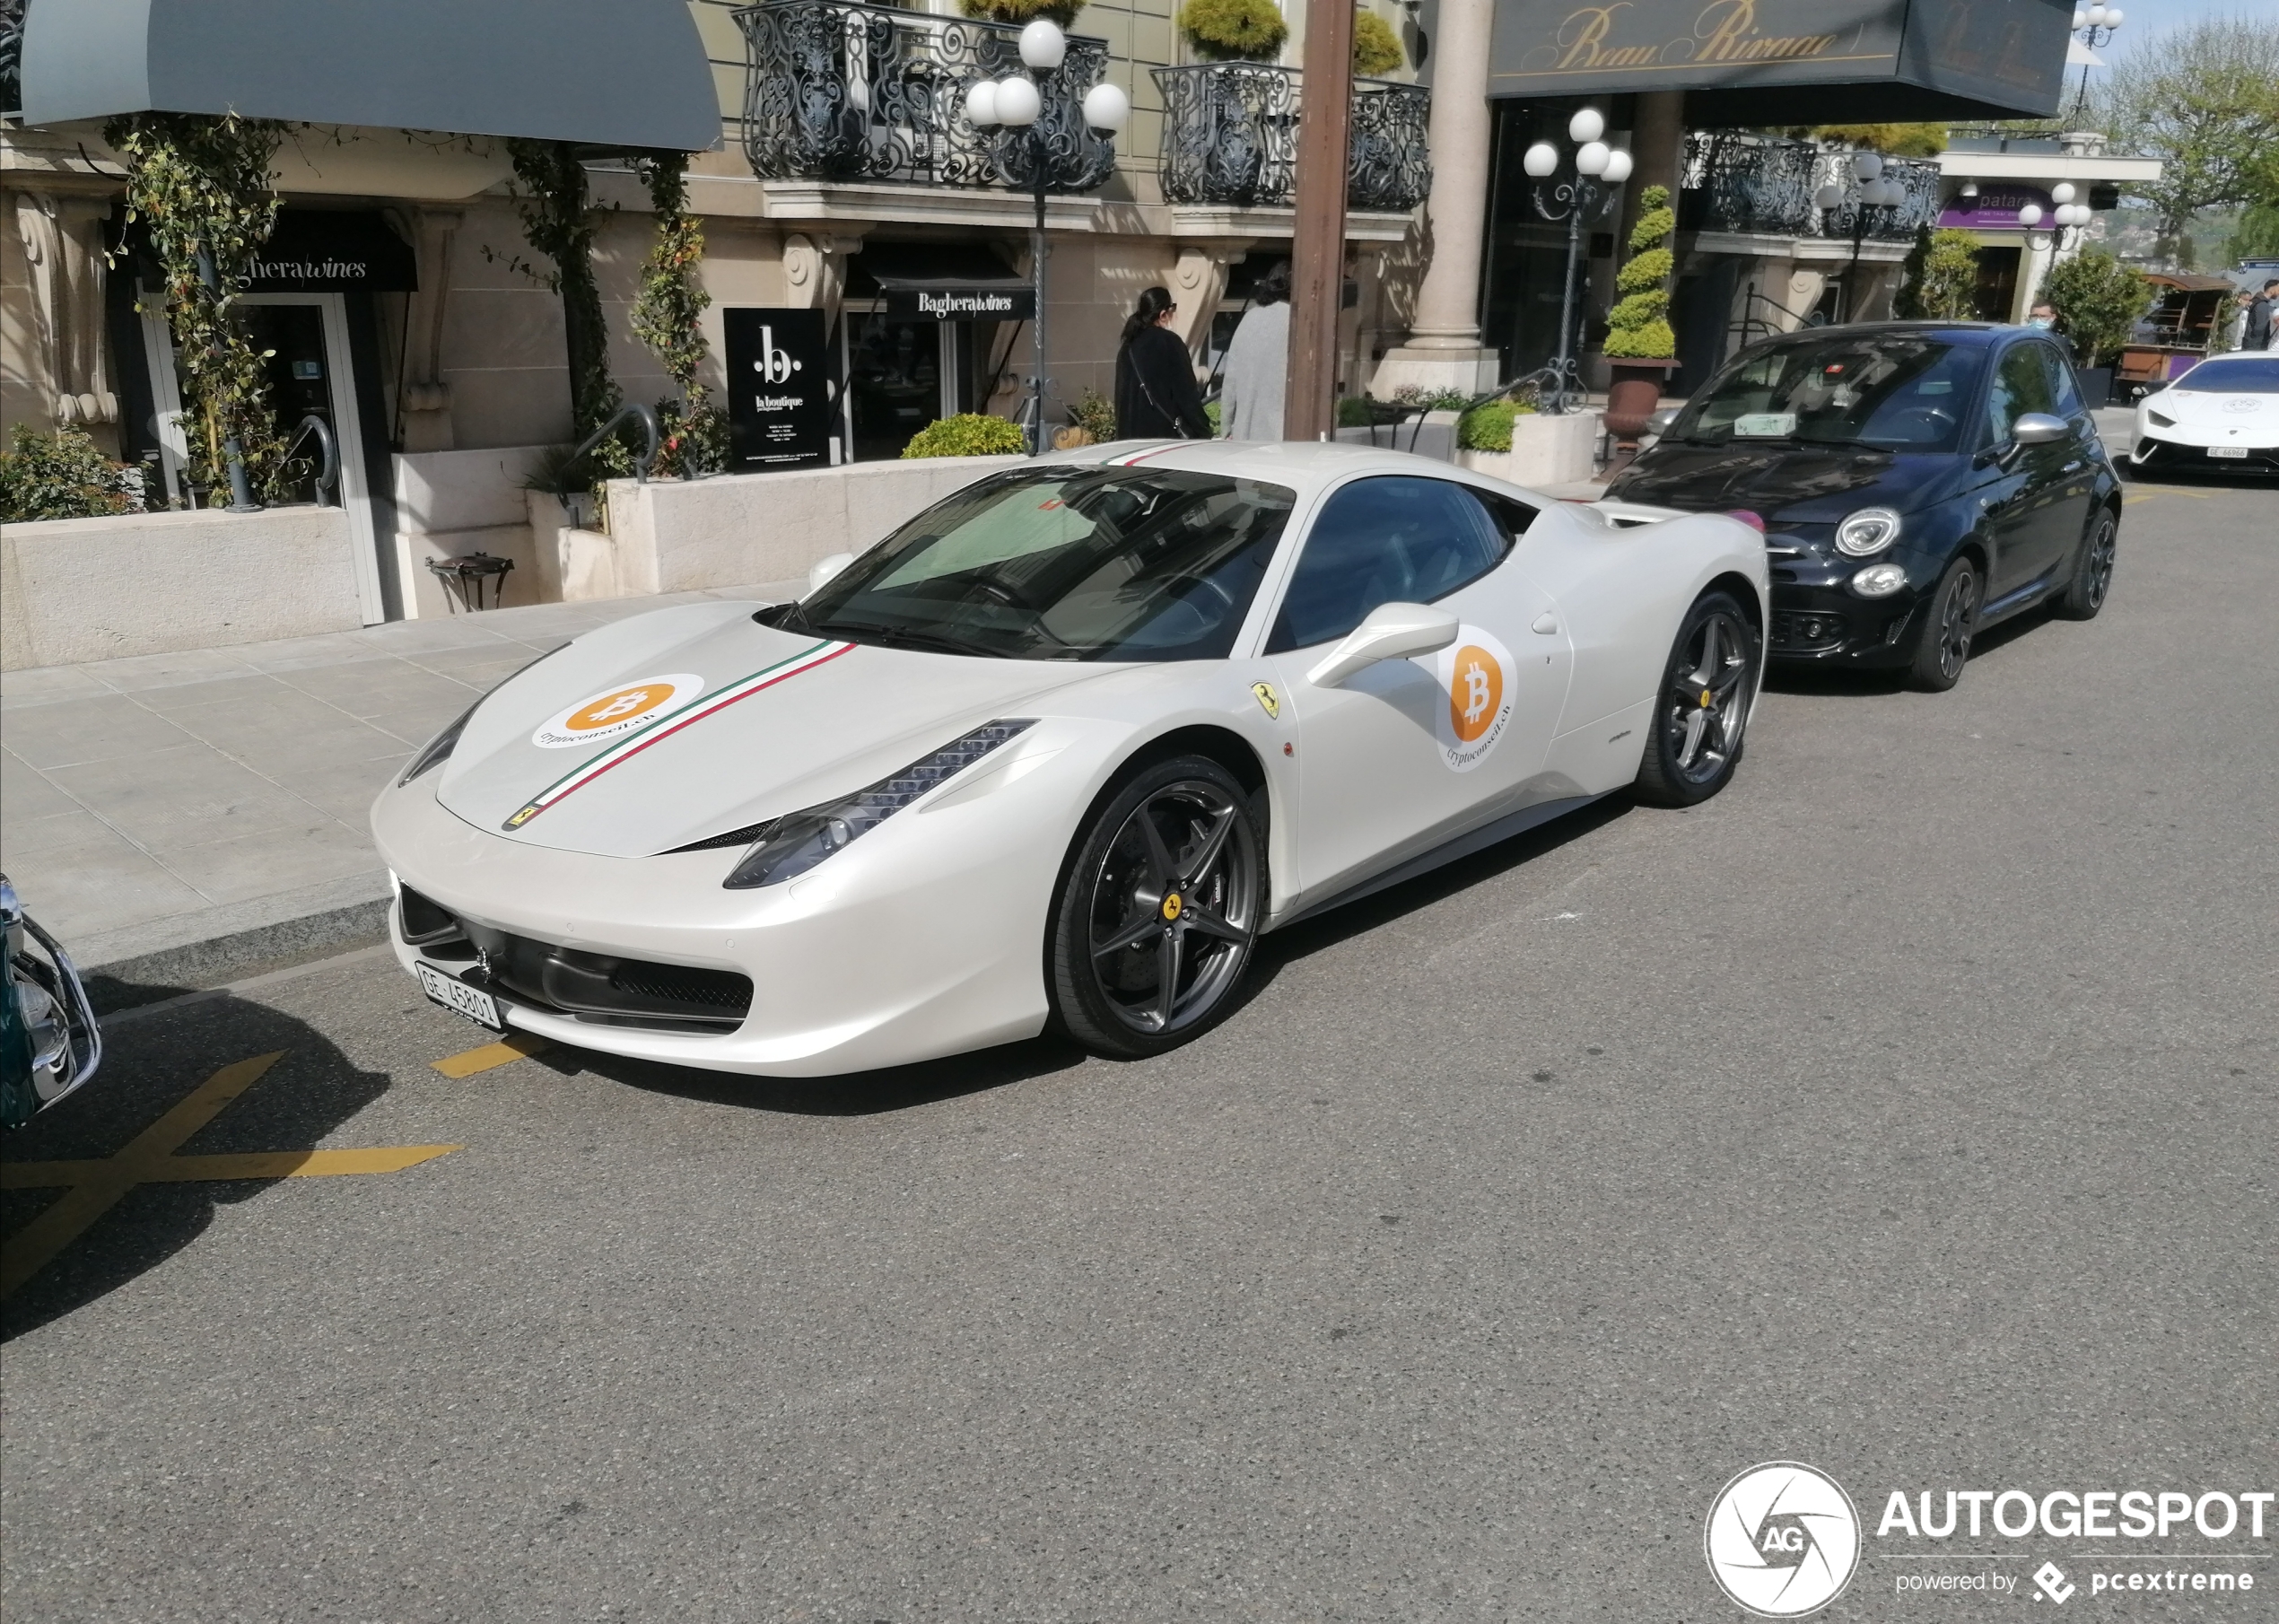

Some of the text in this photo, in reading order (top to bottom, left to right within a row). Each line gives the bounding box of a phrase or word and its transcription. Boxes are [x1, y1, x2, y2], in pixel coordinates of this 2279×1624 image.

[1556, 2, 1659, 69] Beau
[755, 395, 764, 407] la
[764, 395, 804, 410] boutique
[2210, 448, 2219, 456] GE
[540, 713, 657, 745] cryptoconseil.ch
[1446, 704, 1511, 767] cryptoconseil.ch
[423, 970, 443, 999] GE
[448, 982, 494, 1022] 45801
